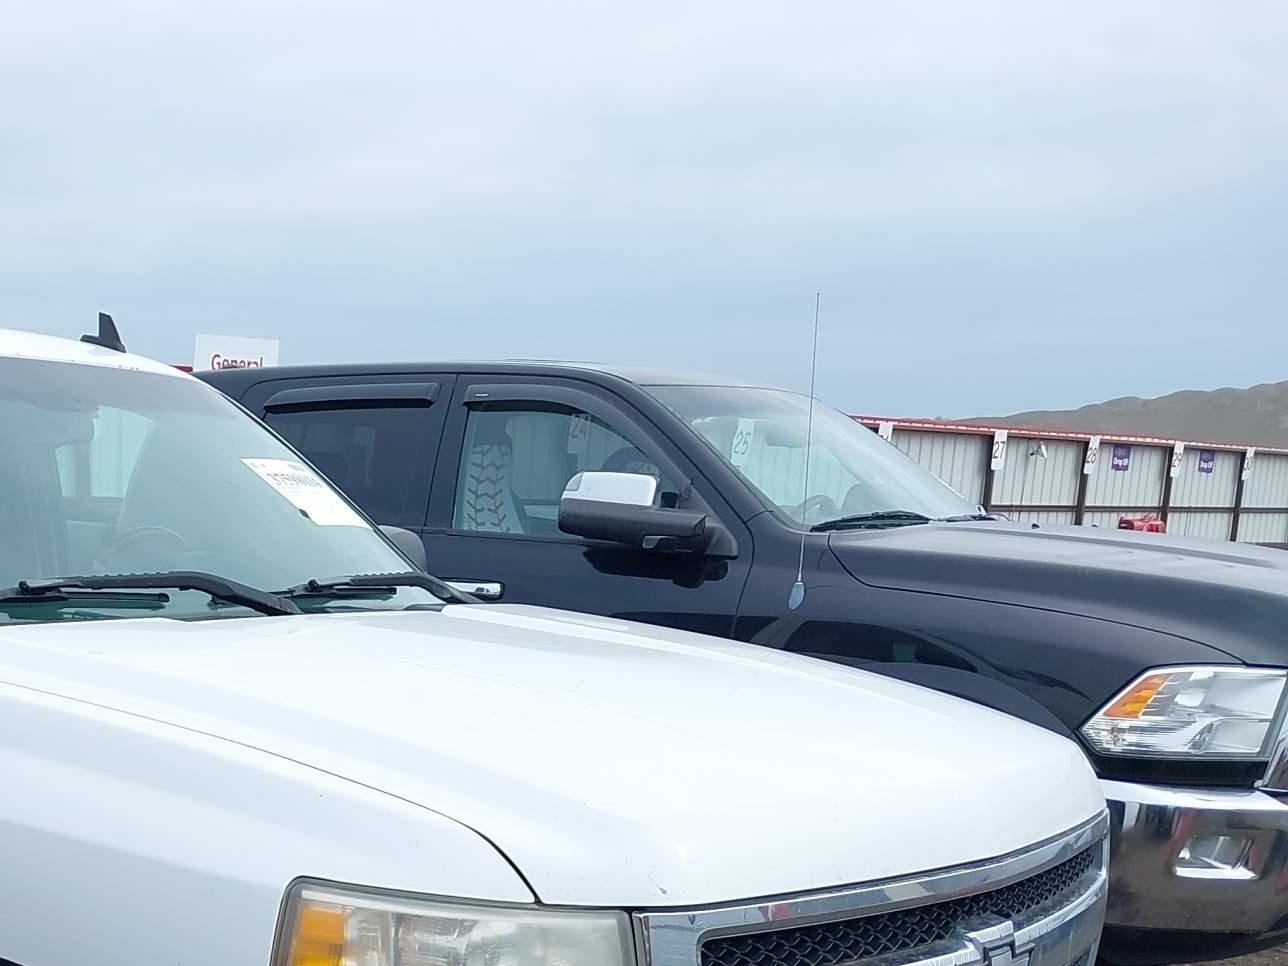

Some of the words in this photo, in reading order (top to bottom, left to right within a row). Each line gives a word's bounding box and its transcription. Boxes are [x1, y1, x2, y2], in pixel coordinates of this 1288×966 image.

[733, 430, 752, 455] 25
[992, 441, 1006, 459] 27
[1086, 447, 1098, 464] 28
